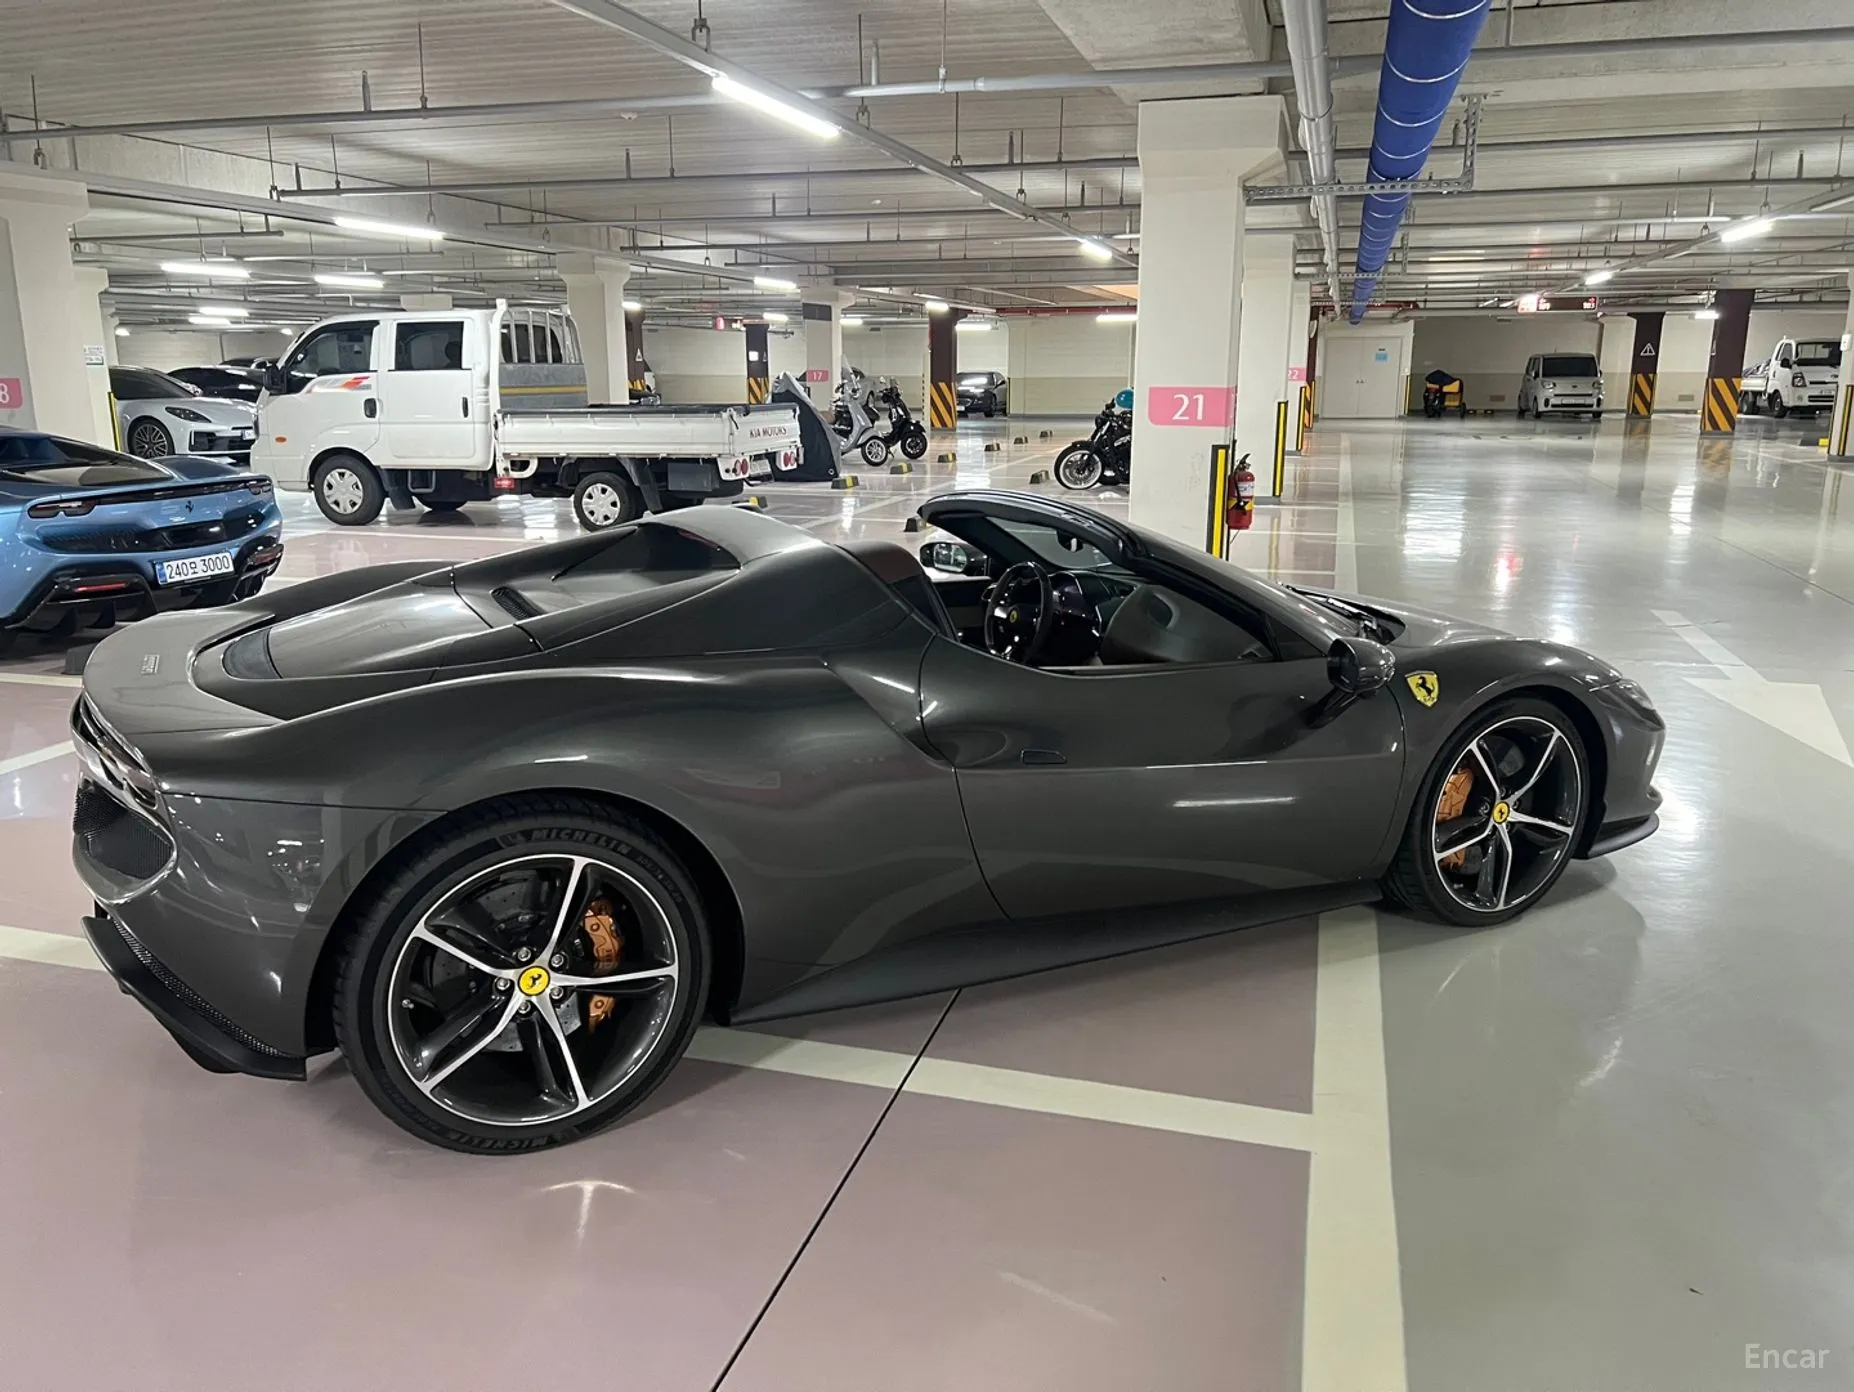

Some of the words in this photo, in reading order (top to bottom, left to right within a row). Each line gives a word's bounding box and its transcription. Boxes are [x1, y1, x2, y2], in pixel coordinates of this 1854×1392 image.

[813, 371, 823, 381] 17
[1172, 393, 1204, 421] 21
[750, 429, 761, 438] KIA
[762, 426, 787, 437] MOTORS
[200, 555, 230, 573] 3000
[530, 828, 631, 855] MICHELIN
